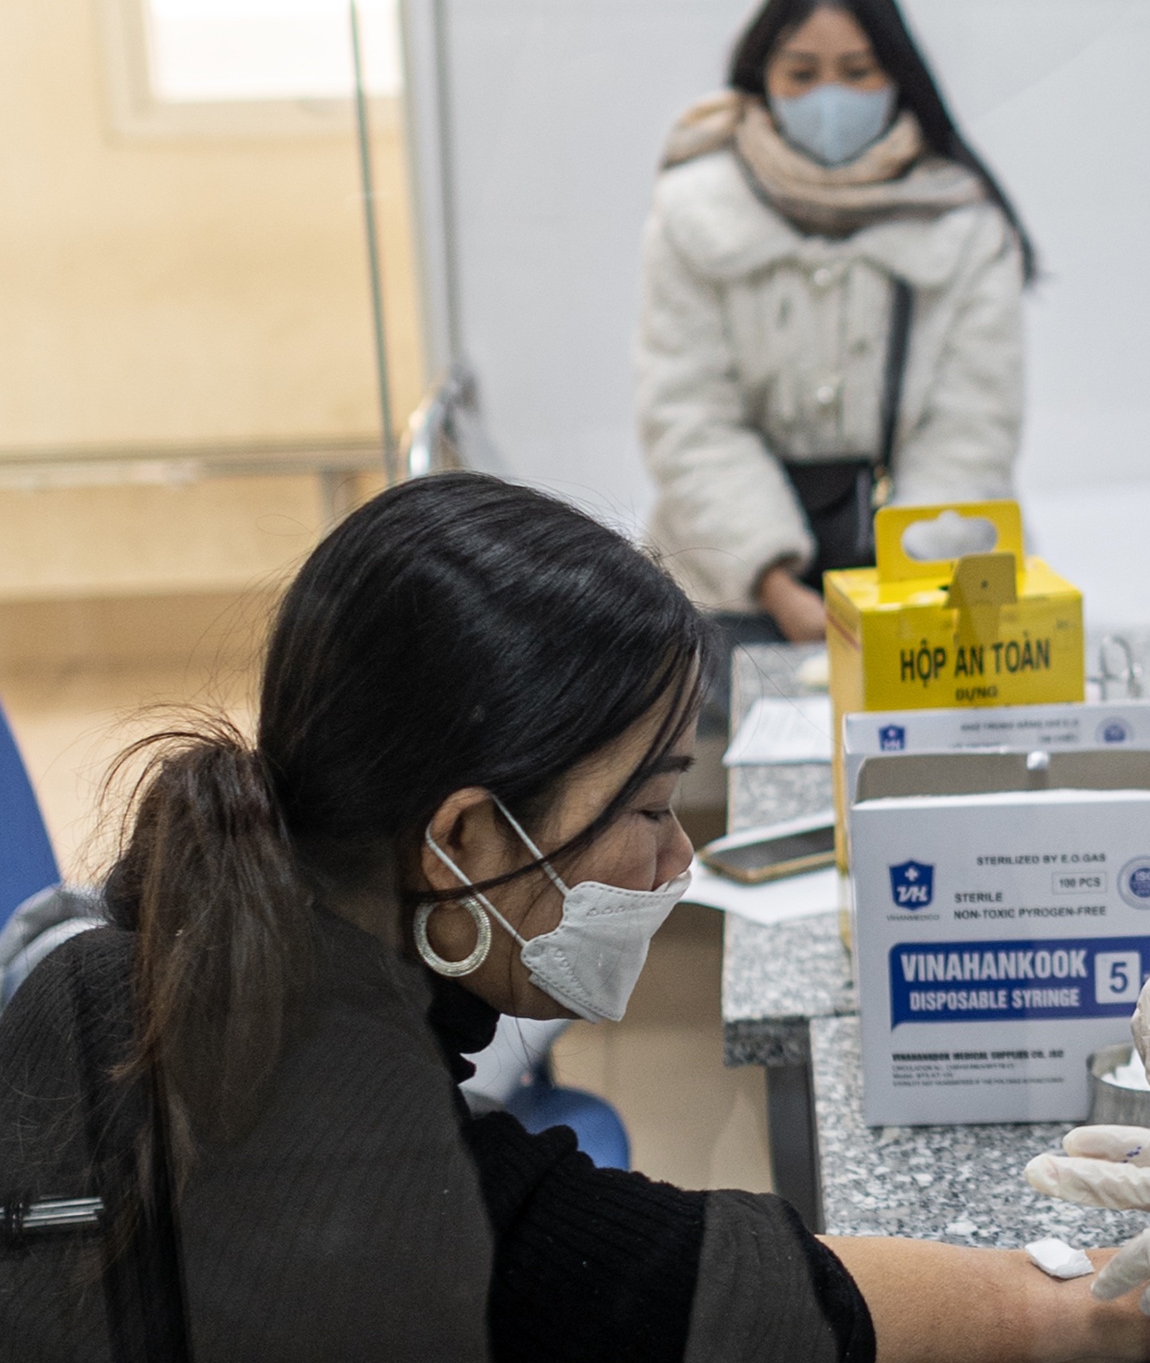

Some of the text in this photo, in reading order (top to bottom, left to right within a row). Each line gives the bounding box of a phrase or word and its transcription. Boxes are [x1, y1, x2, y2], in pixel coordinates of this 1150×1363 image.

[900, 630, 1050, 688] HỘP AN TOÀN
[976, 854, 1040, 867] STERILIZED
[1042, 853, 1058, 865] BY
[1078, 876, 1101, 888] PCS
[954, 892, 1004, 904] STERILE
[953, 906, 1107, 921] NON-TOXIC PYROGEN-FREE
[901, 949, 1088, 982] VINAHANKOOK
[1108, 961, 1129, 994] 5
[909, 988, 1080, 1011] DISPOSABLE SYRINGE
